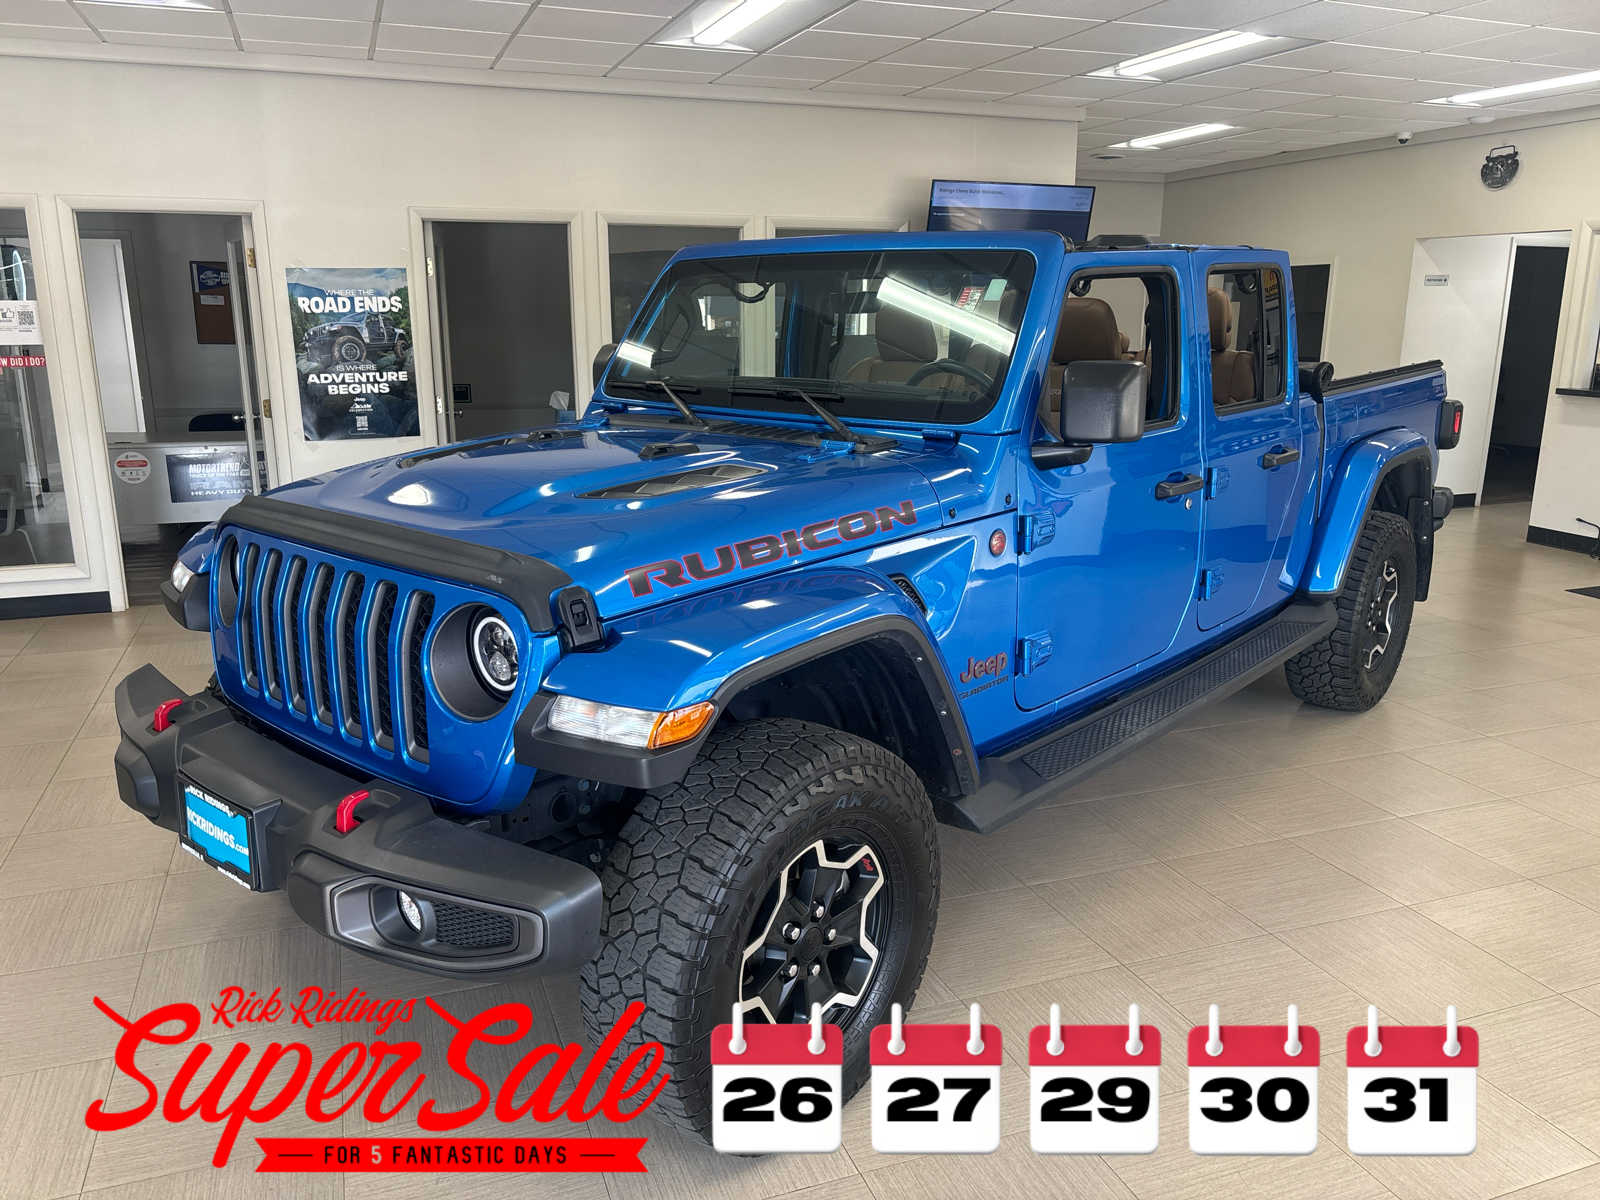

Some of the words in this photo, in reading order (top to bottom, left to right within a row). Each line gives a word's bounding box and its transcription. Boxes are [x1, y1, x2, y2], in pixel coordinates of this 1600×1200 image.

[323, 287, 357, 296] WHERE
[358, 287, 375, 296] THE
[297, 296, 351, 314] ROAD
[355, 295, 402, 313] ENDS
[10, 357, 24, 366] DID
[29, 357, 45, 366] DO?
[336, 364, 344, 372] IS
[345, 363, 377, 372] WHERE
[307, 370, 408, 385] ADVENTURE
[327, 382, 391, 395] BEGINS
[624, 500, 919, 598] RUBICON
[959, 651, 1008, 684] Jeep
